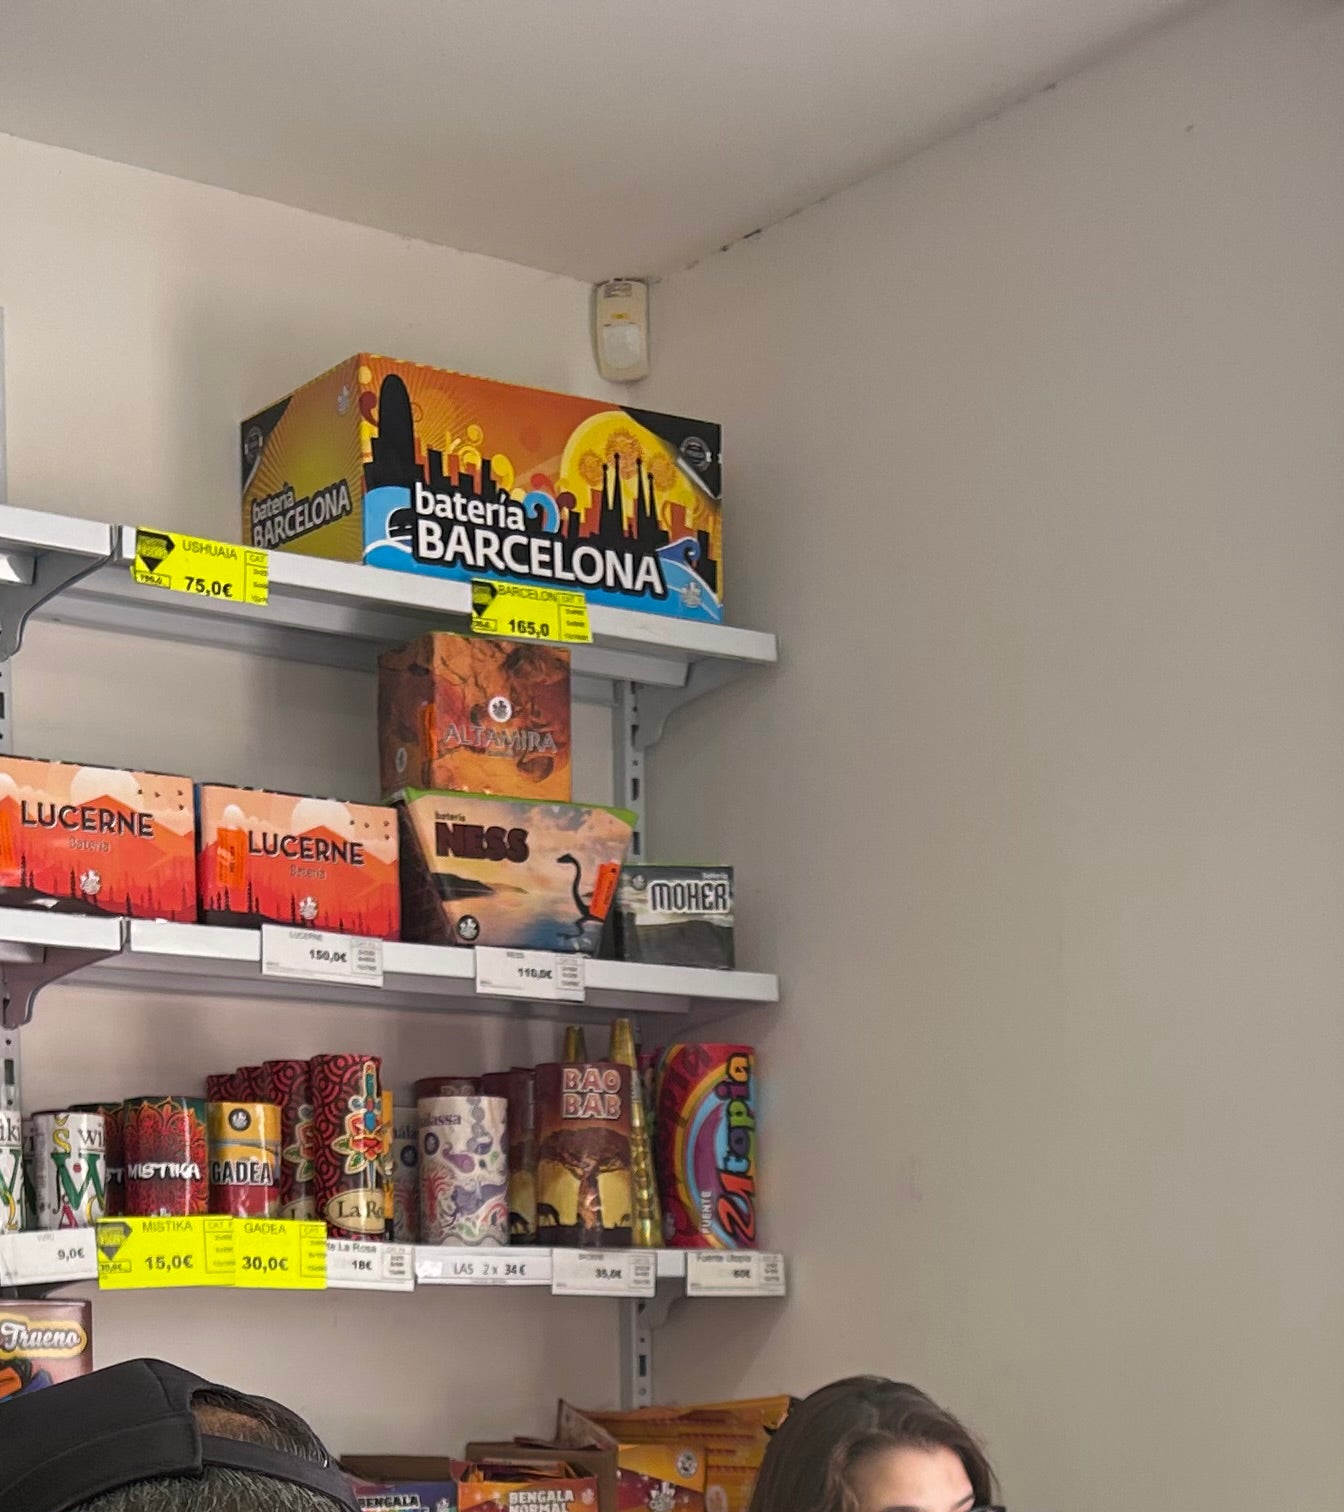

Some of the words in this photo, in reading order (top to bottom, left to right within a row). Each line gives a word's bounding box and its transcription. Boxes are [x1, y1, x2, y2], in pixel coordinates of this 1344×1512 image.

[254, 485, 351, 548] BARCELONA
[415, 482, 525, 532] batería
[182, 539, 239, 561] USHUAIA
[418, 519, 664, 594] BARCELONA
[184, 576, 233, 599] 75,0€
[442, 723, 558, 755] ALTAMIRA
[20, 799, 155, 839] LUCERNE
[248, 830, 366, 867] LUCERNE
[435, 822, 529, 863] NESS
[650, 879, 731, 915] MOHER
[562, 1067, 621, 1094] BAO
[562, 1092, 622, 1120] BAB
[126, 1161, 201, 1181] MISTIKA
[211, 1160, 272, 1187] GADEA
[142, 1220, 193, 1233] MISTIKA
[244, 1222, 287, 1235] GADEA
[57, 1248, 85, 1262] 9,0€
[144, 1254, 193, 1272] 15,0€
[242, 1255, 288, 1273] 30,0€
[509, 1489, 574, 1505] BENGALA
